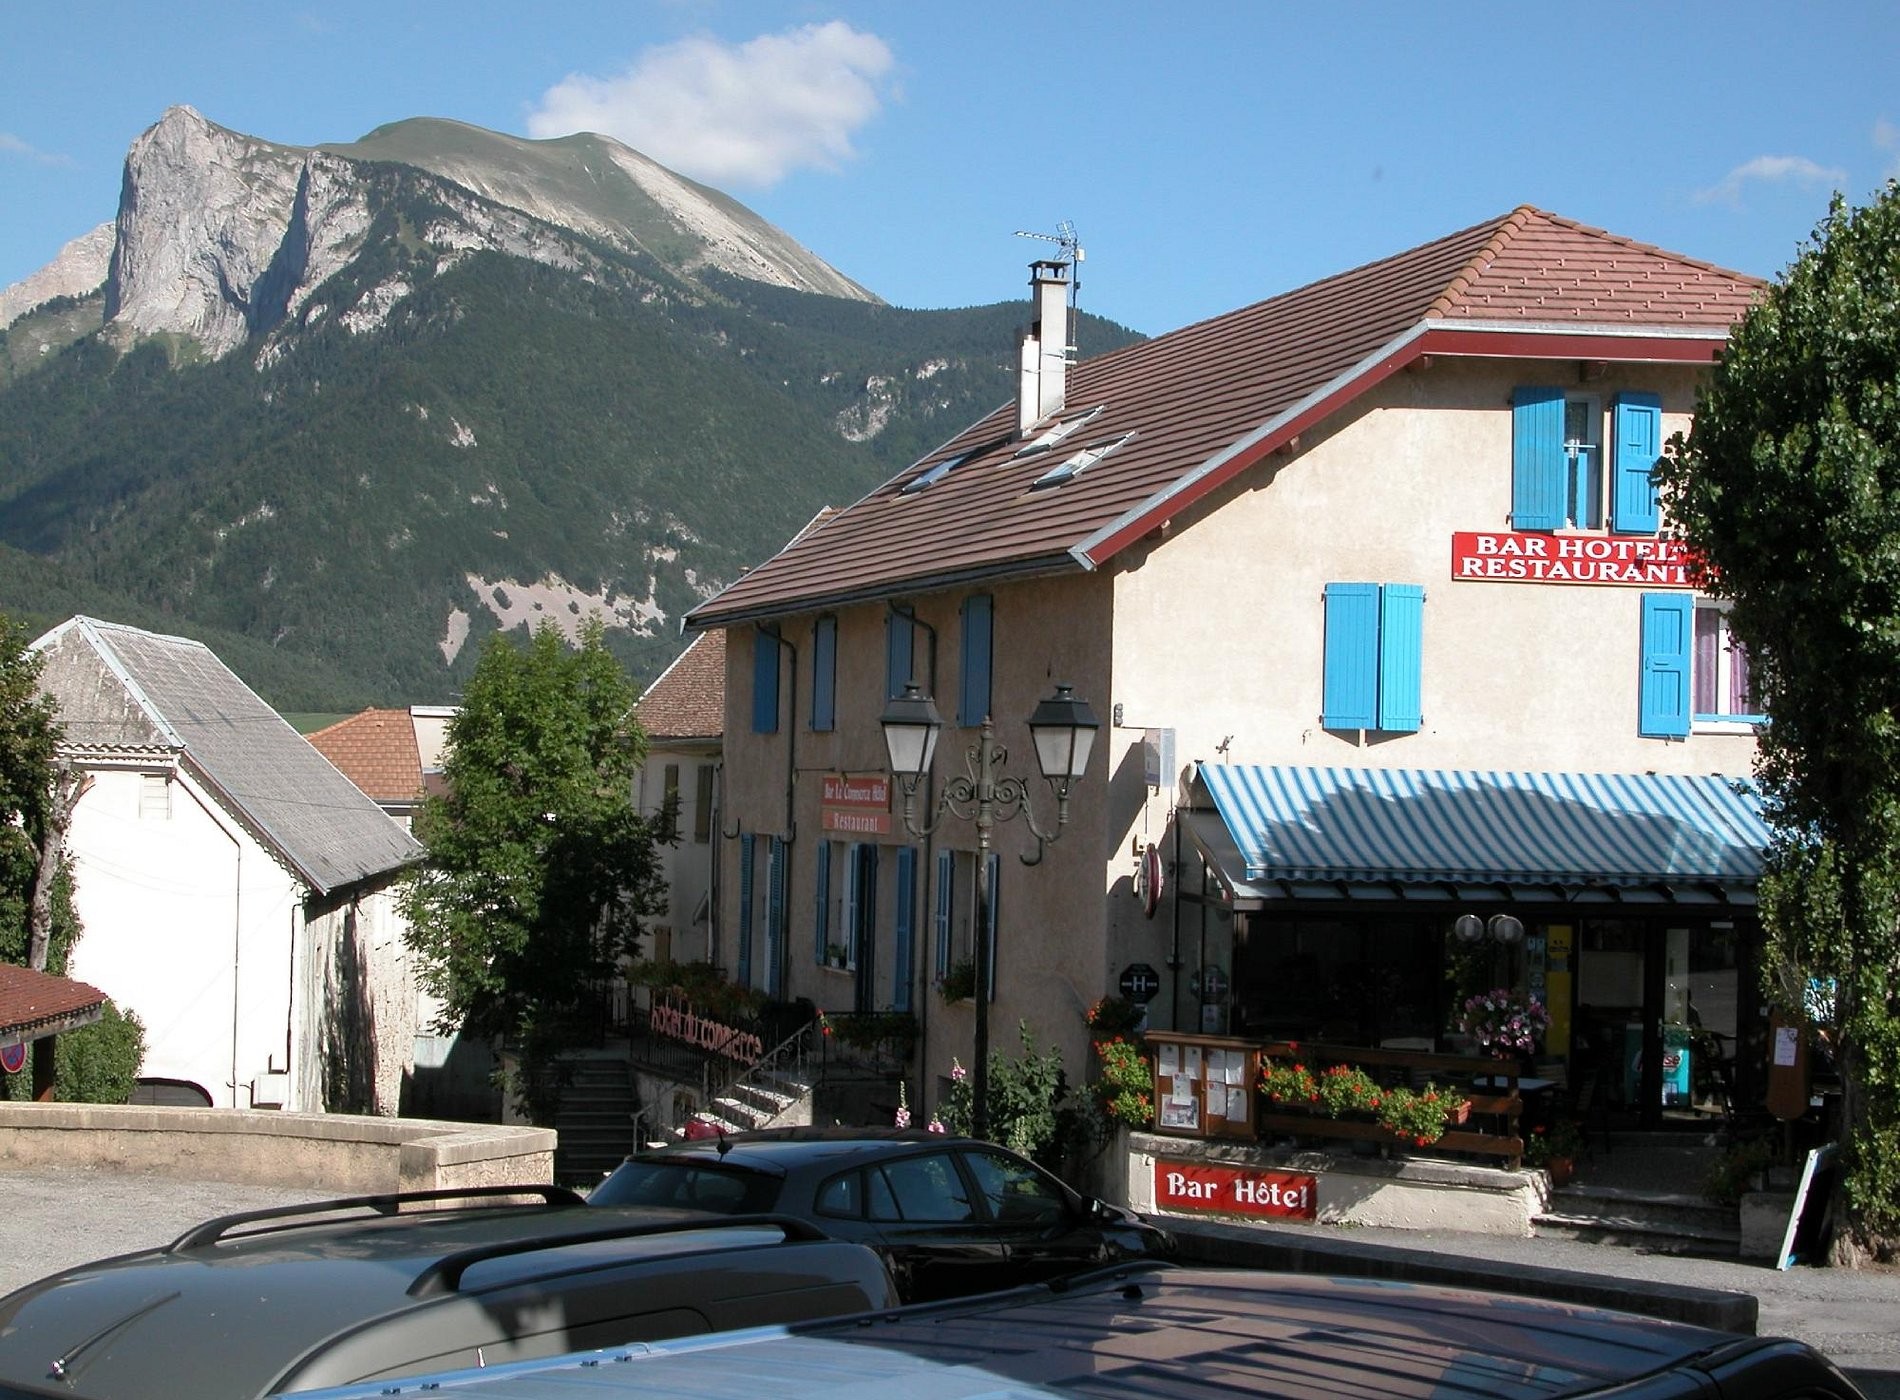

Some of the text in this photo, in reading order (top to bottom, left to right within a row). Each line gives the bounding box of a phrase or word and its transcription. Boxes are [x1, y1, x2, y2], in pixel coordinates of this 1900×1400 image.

[1476, 535, 1678, 562] BAR HOTEL
[1461, 556, 1690, 584] RESTAURANT
[833, 812, 879, 832] Restaurant
[1166, 1172, 1308, 1209] Bar Hôtel
